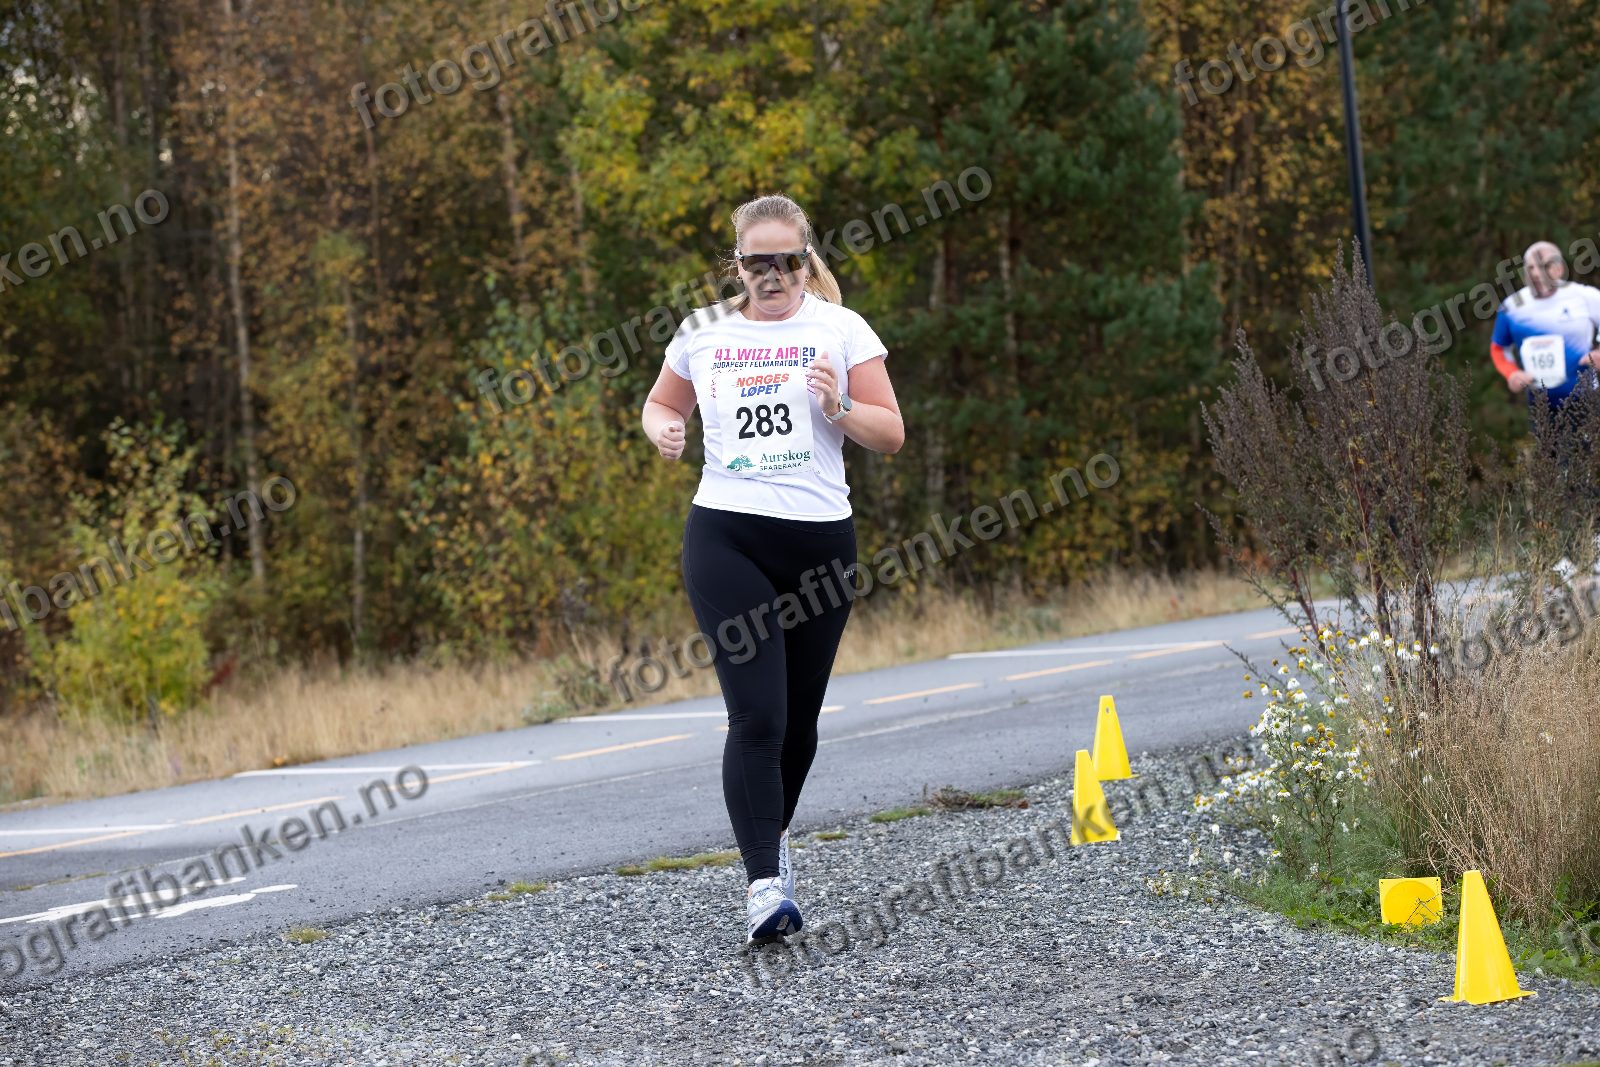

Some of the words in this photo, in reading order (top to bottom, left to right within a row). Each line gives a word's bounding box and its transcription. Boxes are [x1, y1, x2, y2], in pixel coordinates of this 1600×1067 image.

[714, 347, 771, 361] 41.WIZZ
[775, 347, 798, 359] AIR
[802, 347, 816, 357] 20
[802, 358, 815, 367] 2
[1532, 353, 1555, 369] 169
[736, 373, 790, 387] NORGES
[740, 384, 781, 398] LØPET
[736, 403, 793, 439] 283
[759, 450, 811, 463] Aurskog
